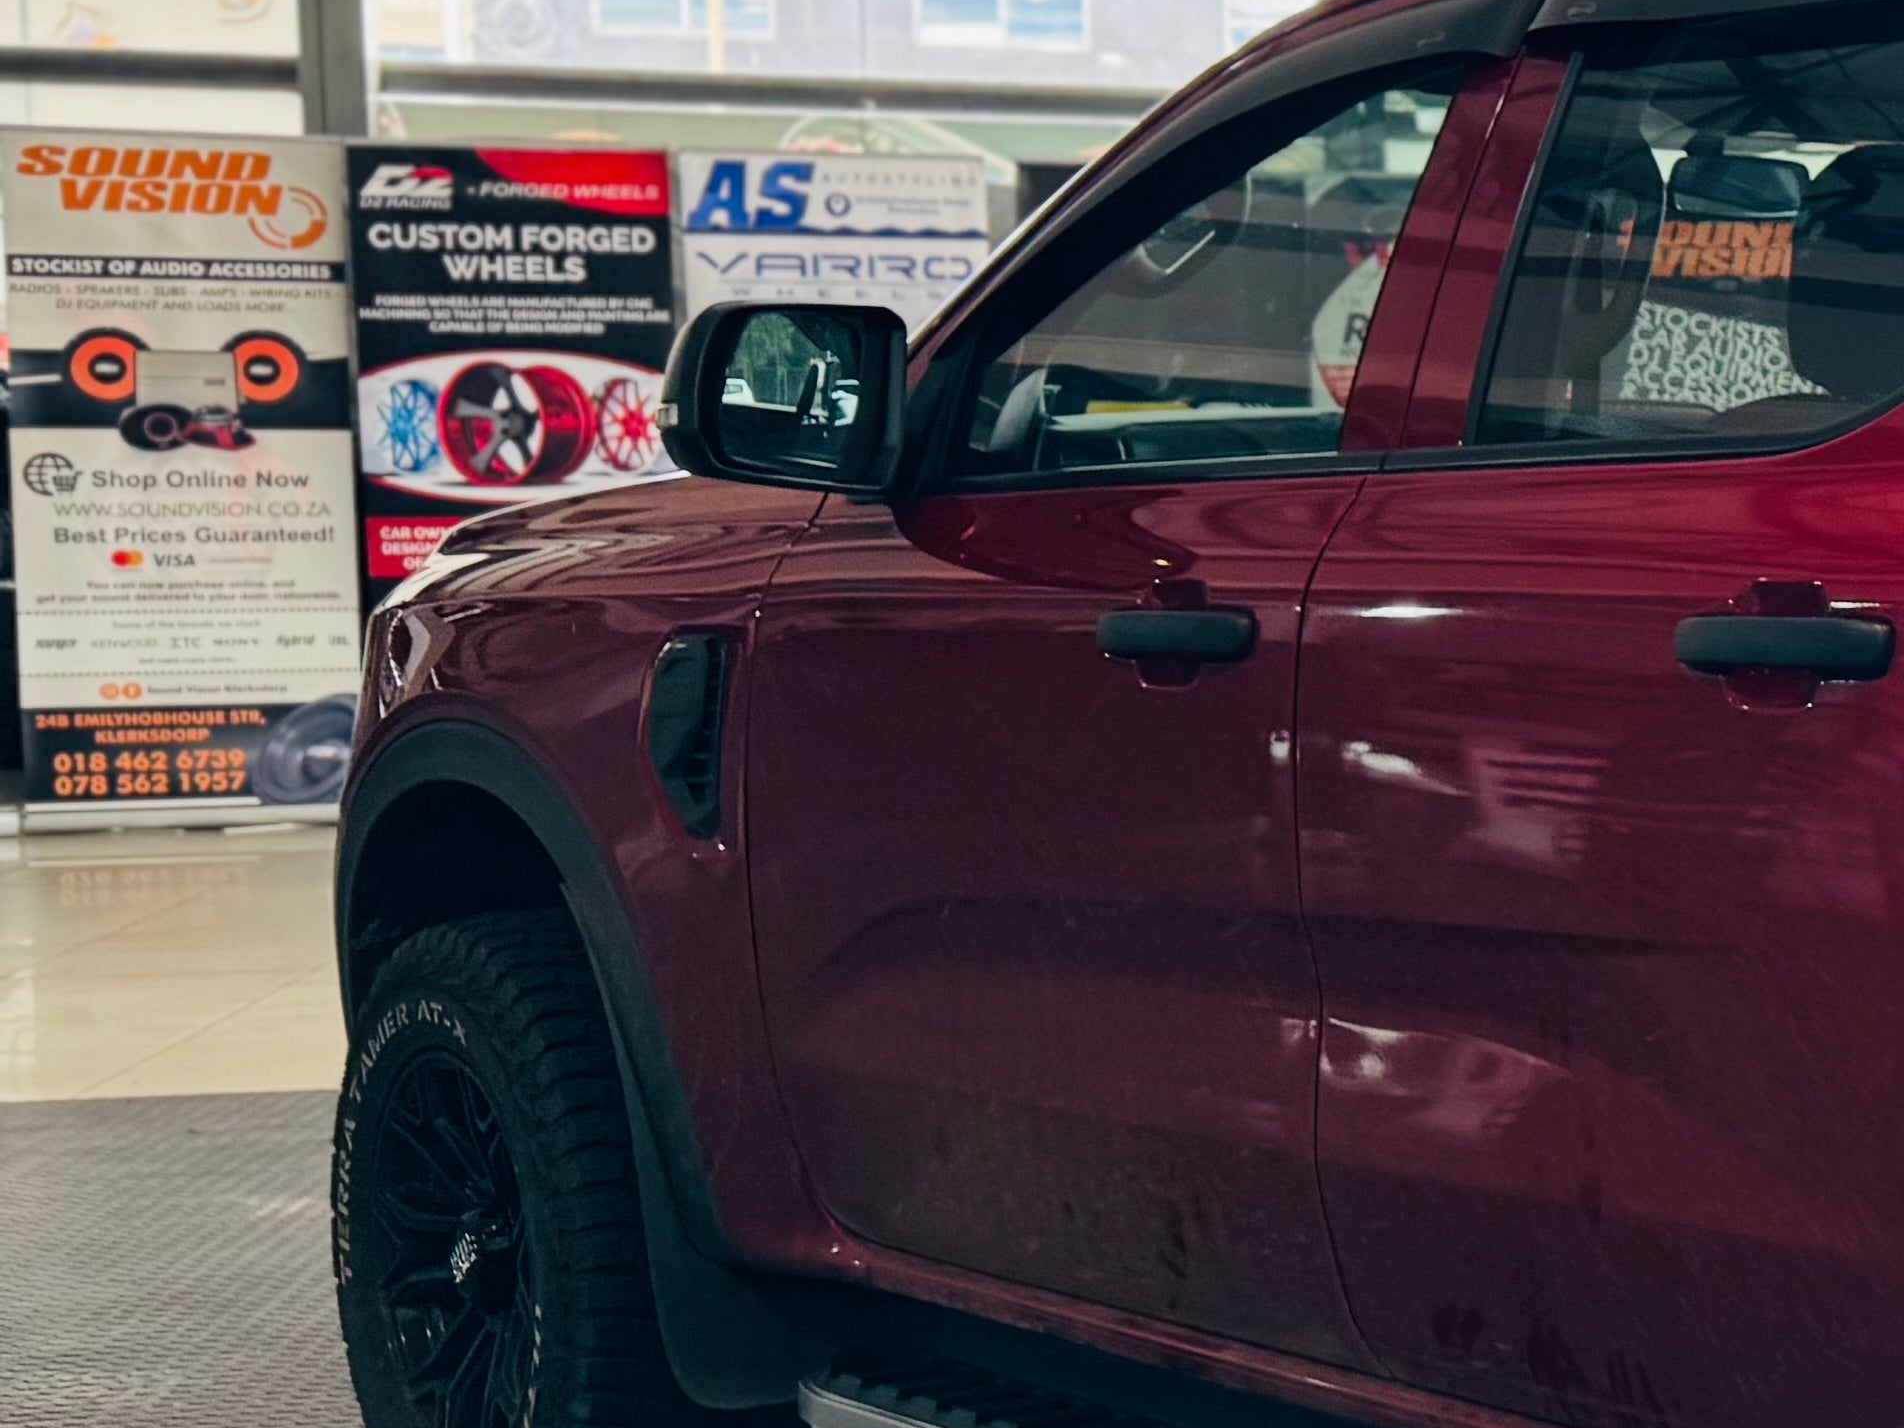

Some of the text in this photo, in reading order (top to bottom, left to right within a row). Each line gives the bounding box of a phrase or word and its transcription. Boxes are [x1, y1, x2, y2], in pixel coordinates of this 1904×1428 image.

[17, 145, 272, 181] SOUND
[60, 179, 283, 216] VISION
[479, 182, 660, 201] FORGED WHEELS
[688, 160, 815, 229] AS
[368, 224, 656, 253] CUSTOM FORGED
[12, 257, 332, 280] STOCKIST OF AUDIO ACCESSORIES
[442, 255, 587, 283] WHEELS
[9, 283, 61, 295] RADIOS
[75, 284, 140, 296] SPEAKERS
[153, 285, 187, 297] SUBS
[250, 288, 300, 299] WIRING
[304, 289, 332, 300] KITS
[76, 299, 159, 311] EQUIPMENT
[162, 300, 193, 311] AND
[197, 301, 241, 312] LOADS
[1637, 299, 1782, 347] STOCKISTS
[1632, 323, 1789, 373] CAR AUDIO
[91, 470, 310, 491] Shop Online Now
[54, 525, 336, 544] Best Prices Guaranteed!
[380, 525, 411, 540] CAR
[153, 553, 196, 568] VISA
[94, 727, 212, 744] KLERKSDORP
[53, 748, 246, 773] 018 462 6739
[54, 770, 247, 796] 078 562 1957
